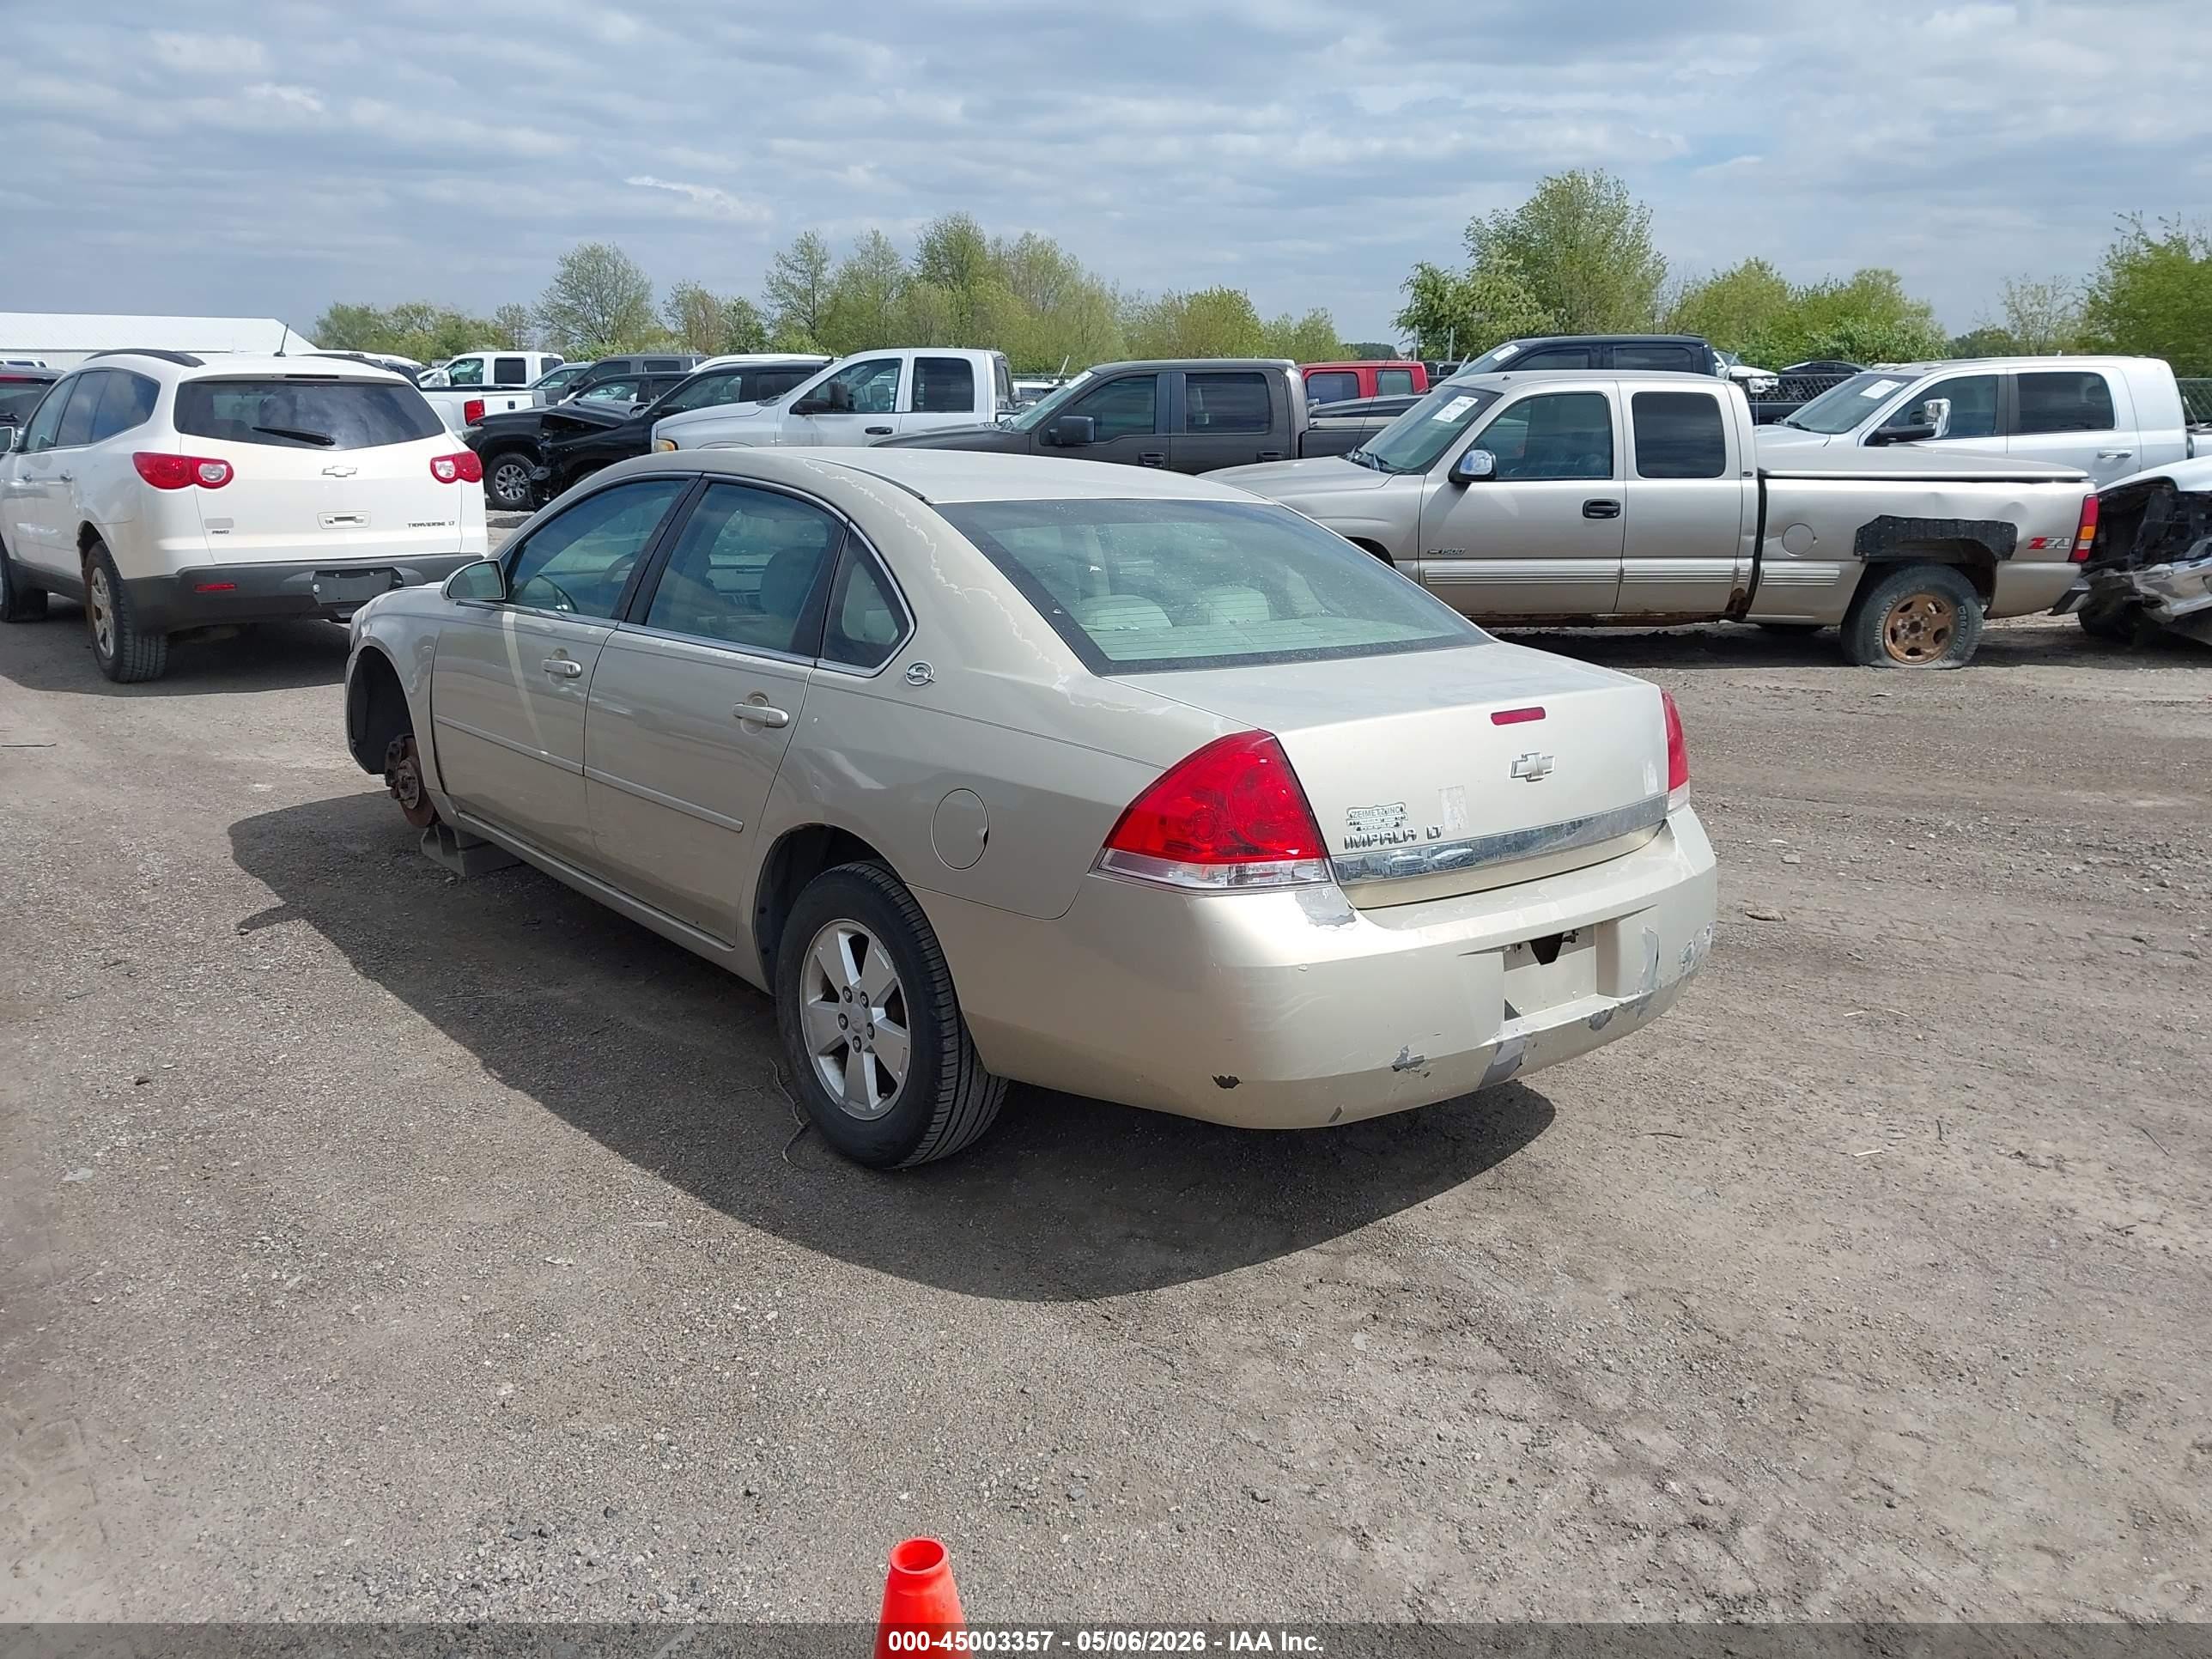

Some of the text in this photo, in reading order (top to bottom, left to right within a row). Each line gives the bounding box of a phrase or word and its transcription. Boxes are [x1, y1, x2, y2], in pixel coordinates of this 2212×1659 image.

[2027, 536, 2071, 550] Z71
[1352, 807, 1385, 819] ZEIMETZ
[1343, 824, 1443, 849] IMPALA LT
